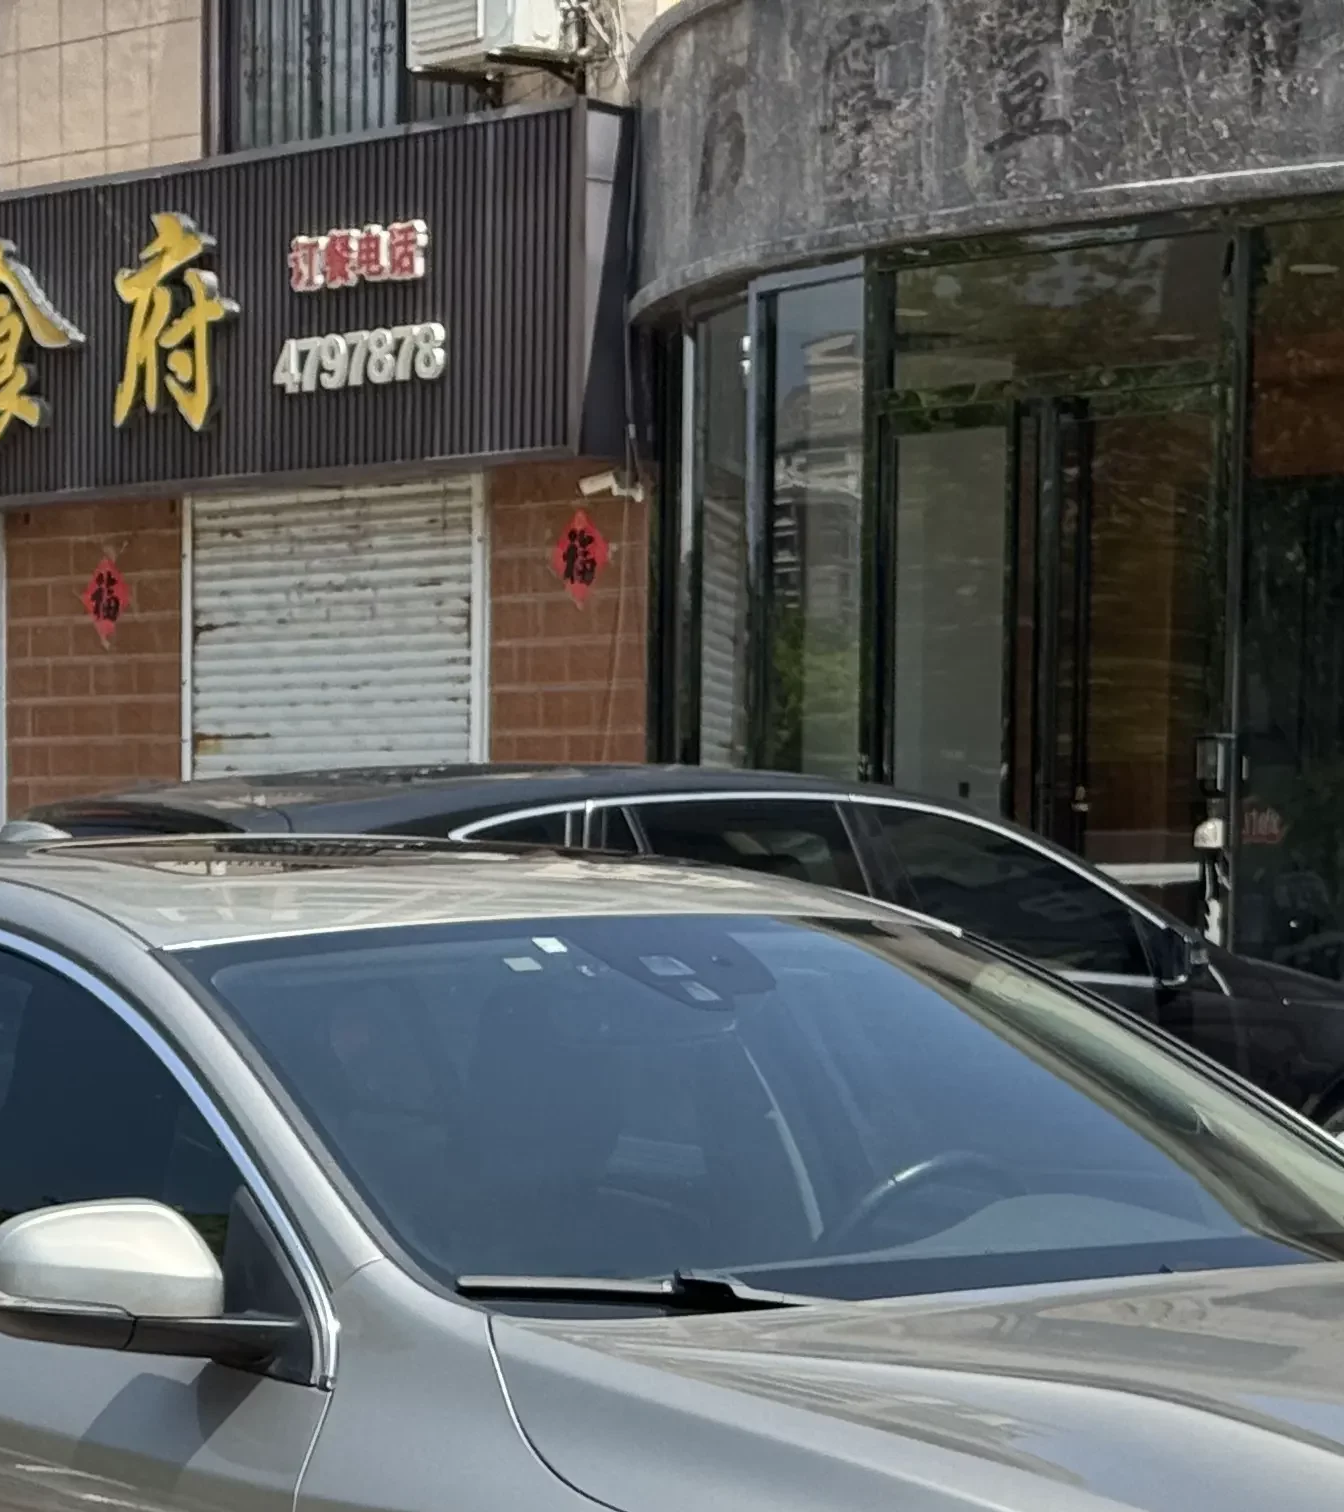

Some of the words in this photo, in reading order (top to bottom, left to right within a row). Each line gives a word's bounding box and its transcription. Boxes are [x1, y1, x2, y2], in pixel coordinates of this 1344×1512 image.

[288, 219, 428, 292] 订餐电话
[273, 322, 445, 394] 4797878
[563, 529, 597, 586] 福
[90, 571, 121, 621] 福
